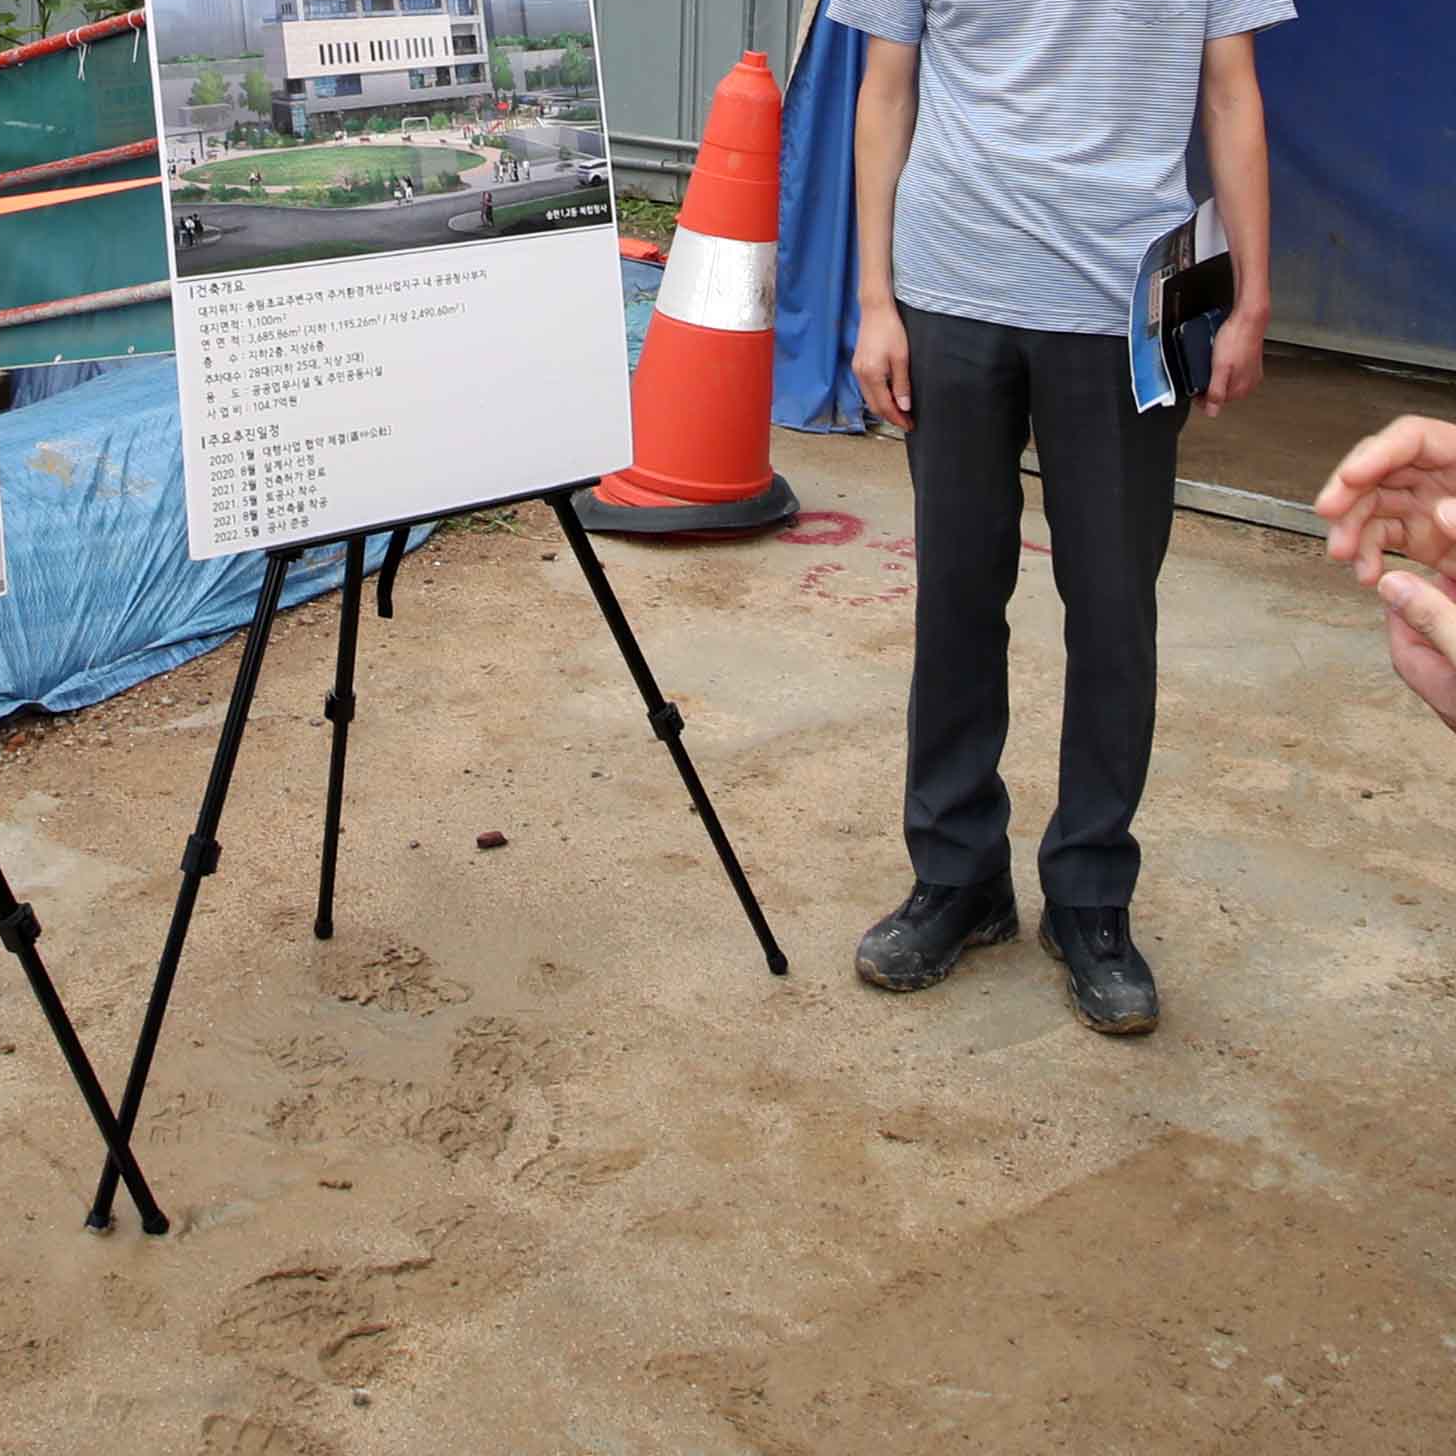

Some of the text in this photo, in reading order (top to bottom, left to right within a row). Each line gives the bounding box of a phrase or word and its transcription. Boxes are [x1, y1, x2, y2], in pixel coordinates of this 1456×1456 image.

[197, 280, 246, 298] 건축개요
[390, 311, 408, 323] 지상
[208, 424, 280, 447] 주요추진일정
